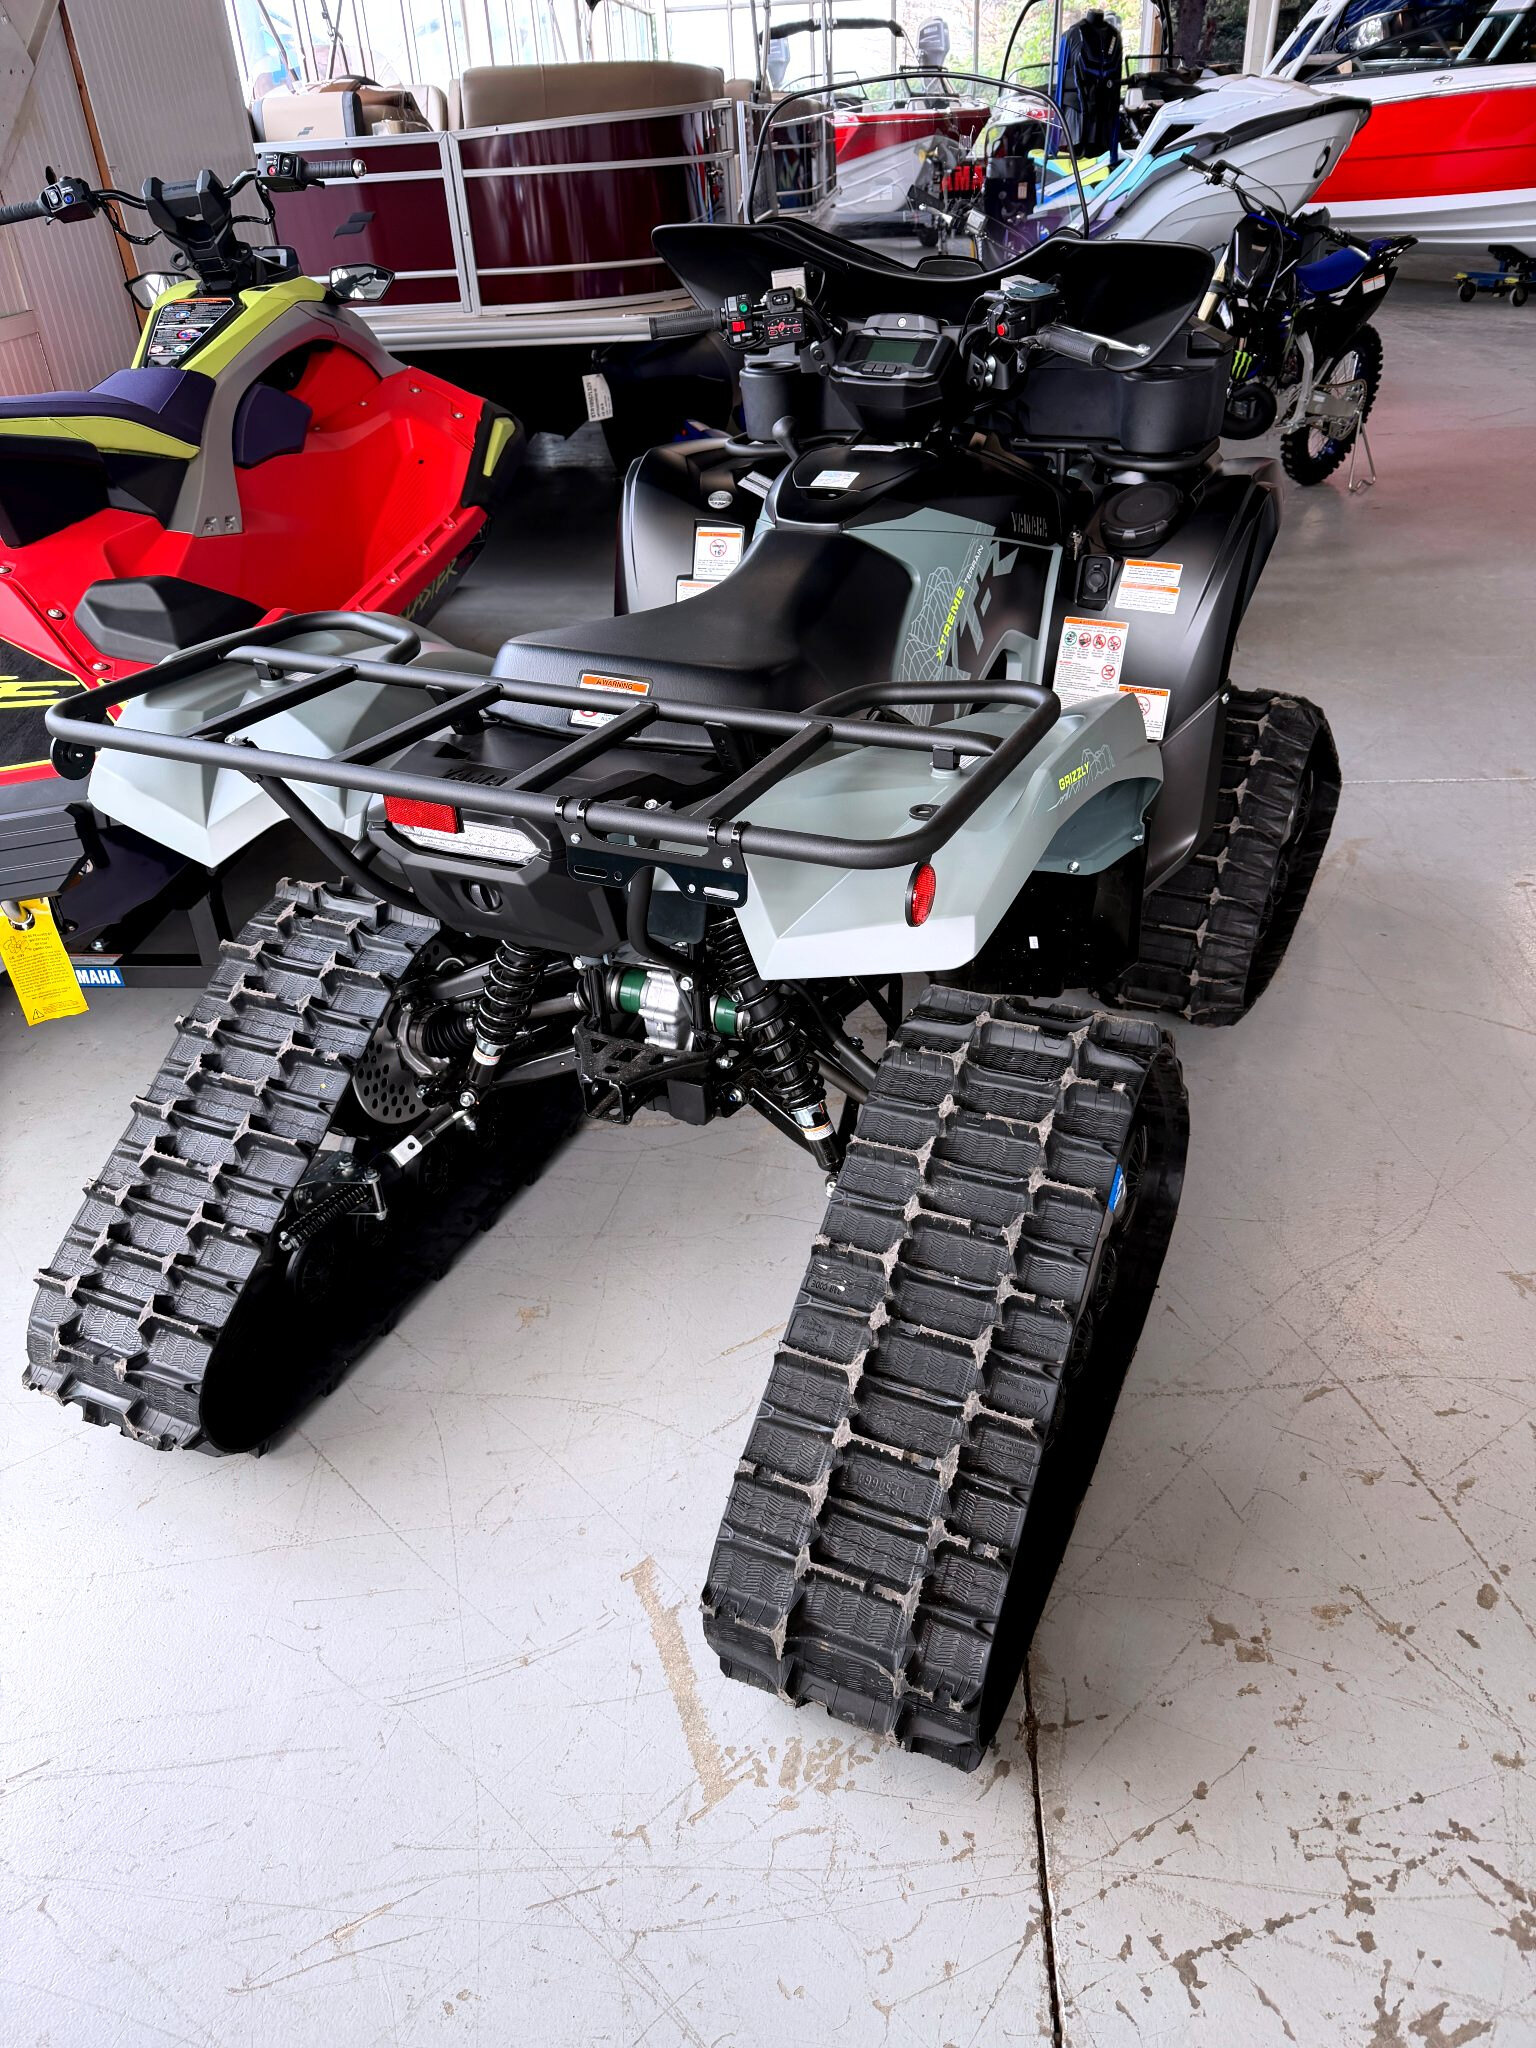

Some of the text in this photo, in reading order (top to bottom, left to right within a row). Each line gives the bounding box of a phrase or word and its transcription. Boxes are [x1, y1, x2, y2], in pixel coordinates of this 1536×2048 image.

[1010, 511, 1048, 538] YAMAHA
[936, 544, 984, 661] XTREME TERRAIN
[602, 679, 633, 690] WARNING
[1058, 761, 1090, 791] GRIZZLY
[75, 969, 122, 985] MAHA
